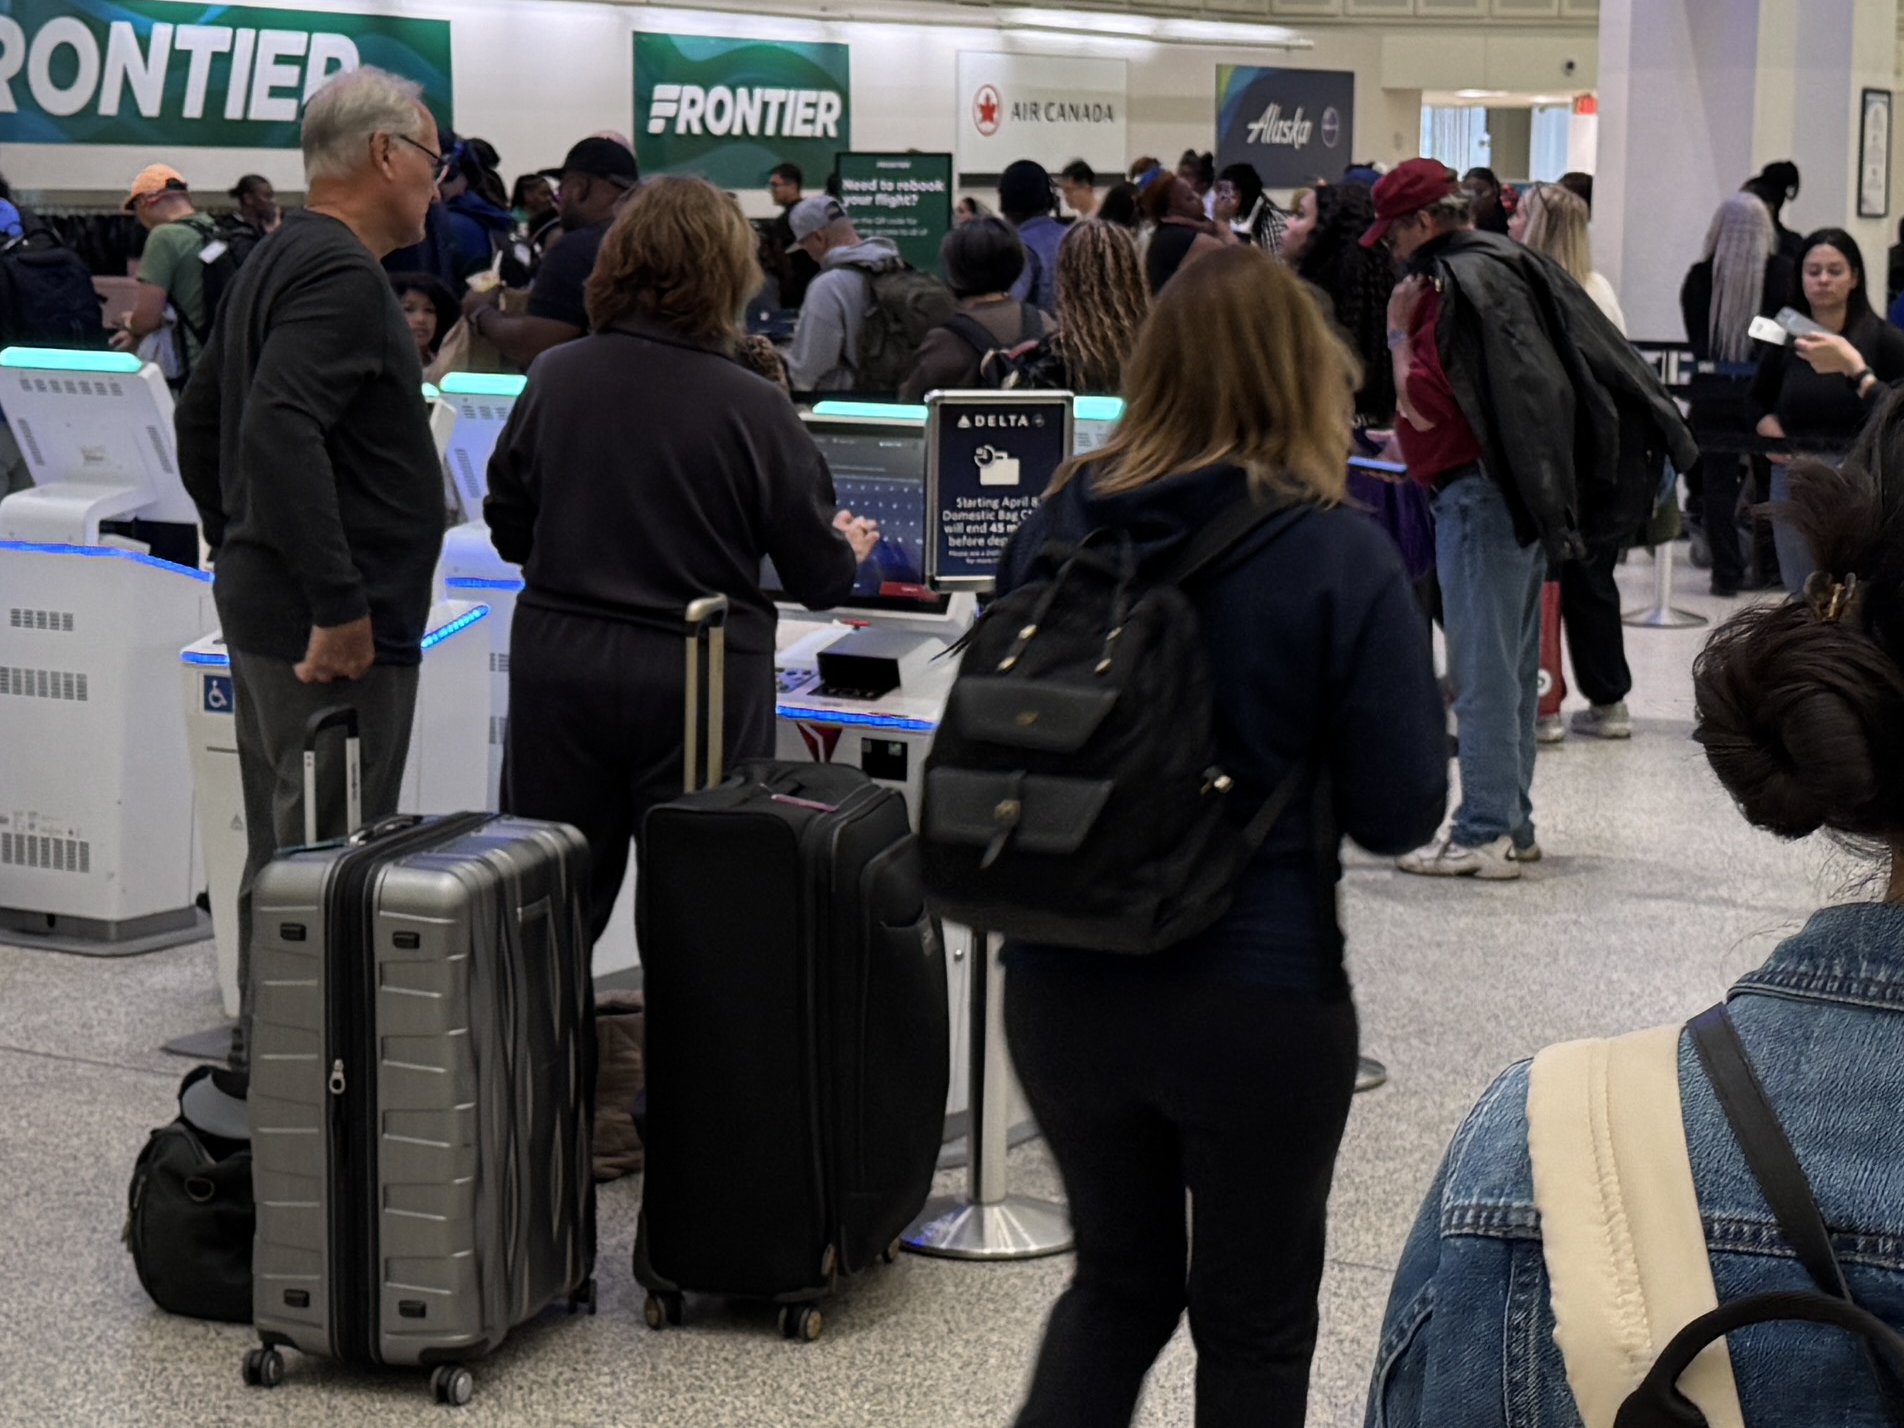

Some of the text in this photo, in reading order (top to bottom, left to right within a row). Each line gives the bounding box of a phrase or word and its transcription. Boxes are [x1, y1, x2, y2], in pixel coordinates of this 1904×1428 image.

[647, 83, 842, 139] FRONTIER
[1010, 100, 1115, 124] AIR CANADA
[1246, 101, 1313, 150] Alaska
[842, 179, 945, 192] Need to rebook
[842, 194, 919, 209] your flight?
[975, 415, 1029, 427] DELTA
[956, 496, 1029, 510] Starting April
[942, 510, 1018, 522] Domestic Bag
[944, 523, 1004, 534] will end 45
[948, 536, 985, 547] before
